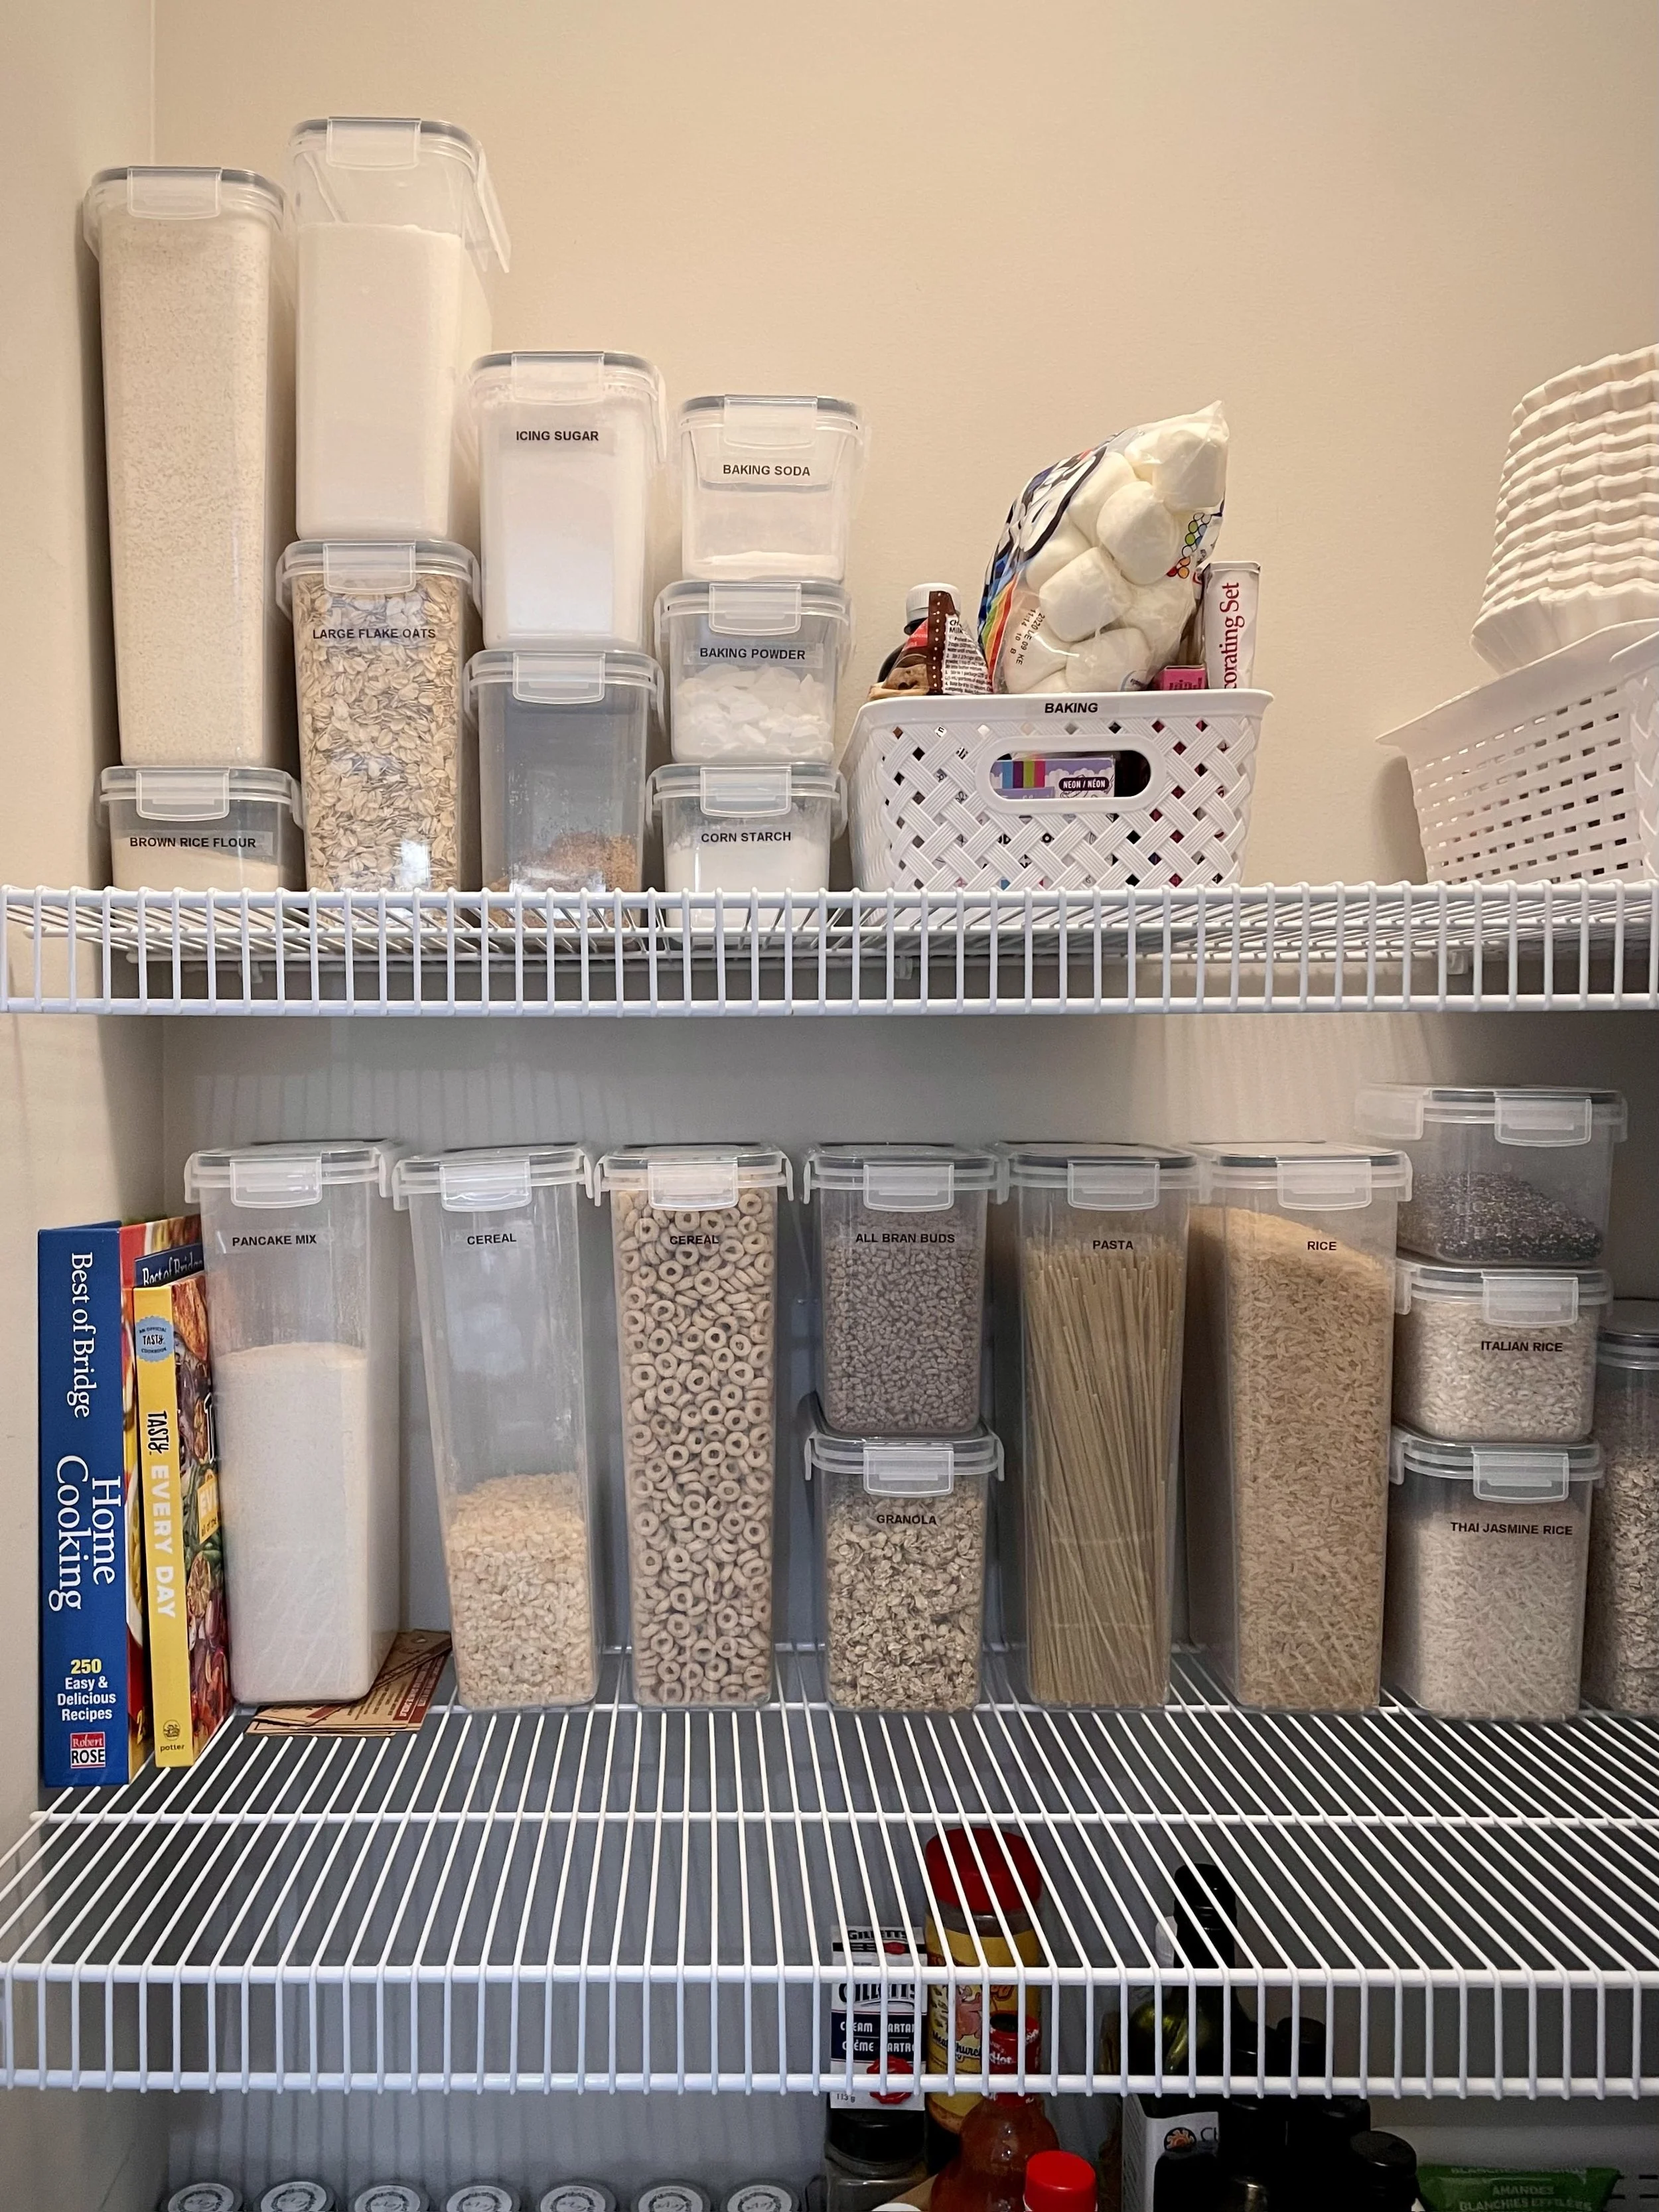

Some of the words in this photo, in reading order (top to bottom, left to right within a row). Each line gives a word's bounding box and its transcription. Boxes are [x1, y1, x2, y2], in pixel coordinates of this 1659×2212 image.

[516, 431, 550, 441] ICING
[554, 431, 599, 441] SUGAR
[723, 464, 770, 475] BAKING
[774, 466, 810, 476] SODA
[1220, 582, 1240, 613] Set
[1031, 612, 1045, 630] 2020
[313, 628, 354, 639] LARGE
[358, 629, 398, 638] FLAKE
[402, 628, 436, 638] OATS
[1021, 641, 1028, 650] 09
[700, 648, 747, 658] BAKING
[751, 649, 806, 659] POWDER
[1016, 653, 1025, 665] KE
[1045, 703, 1098, 713] BAKING
[1062, 780, 1081, 789] NEON
[1087, 778, 1106, 788] NÉON
[130, 837, 176, 847] BROWN
[180, 837, 209, 847] RICE
[213, 838, 256, 848] FLOUR
[701, 833, 737, 843] CORN
[741, 831, 791, 842] STARCH
[232, 1235, 292, 1246] PANCAKE
[295, 1235, 317, 1244] MIX
[467, 1233, 517, 1245] CEREAL
[670, 1235, 719, 1245] CEREAL
[855, 1233, 879, 1243] ALL
[882, 1233, 916, 1243] BRAN
[920, 1233, 955, 1243] BUDS
[1093, 1240, 1134, 1250] PASTA
[1307, 1241, 1337, 1251] RICE
[72, 1252, 93, 1304] Best
[72, 1308, 97, 1334] of
[143, 1334, 164, 1346] TASTY
[1480, 1341, 1529, 1351] ITALIAN
[1533, 1342, 1563, 1352] RICE
[66, 1338, 97, 1418] Bridge
[147, 1411, 169, 1454] TASTY
[151, 1464, 173, 1555] EVERY
[876, 1515, 937, 1525] GRANOLA
[48, 1455, 92, 1612] Cooking
[92, 1476, 121, 1585] Home
[1450, 1522, 1479, 1533] THAI
[1482, 1523, 1539, 1535] JASMINE
[1543, 1525, 1573, 1535] RICE
[156, 1566, 176, 1619] DAY
[70, 1659, 102, 1675] 250
[65, 1677, 95, 1691] Easy
[98, 1676, 108, 1689] &
[57, 1693, 116, 1706] Delicious
[62, 1708, 113, 1722] Recipes
[72, 1734, 104, 1748] Robert
[160, 1744, 185, 1753] potter
[72, 1749, 105, 1764] ROSE
[840, 2021, 873, 2032] CEAM
[888, 2023, 914, 2033] ARTA
[842, 2039, 874, 2051] CÈME
[887, 2042, 914, 2053] ARTR
